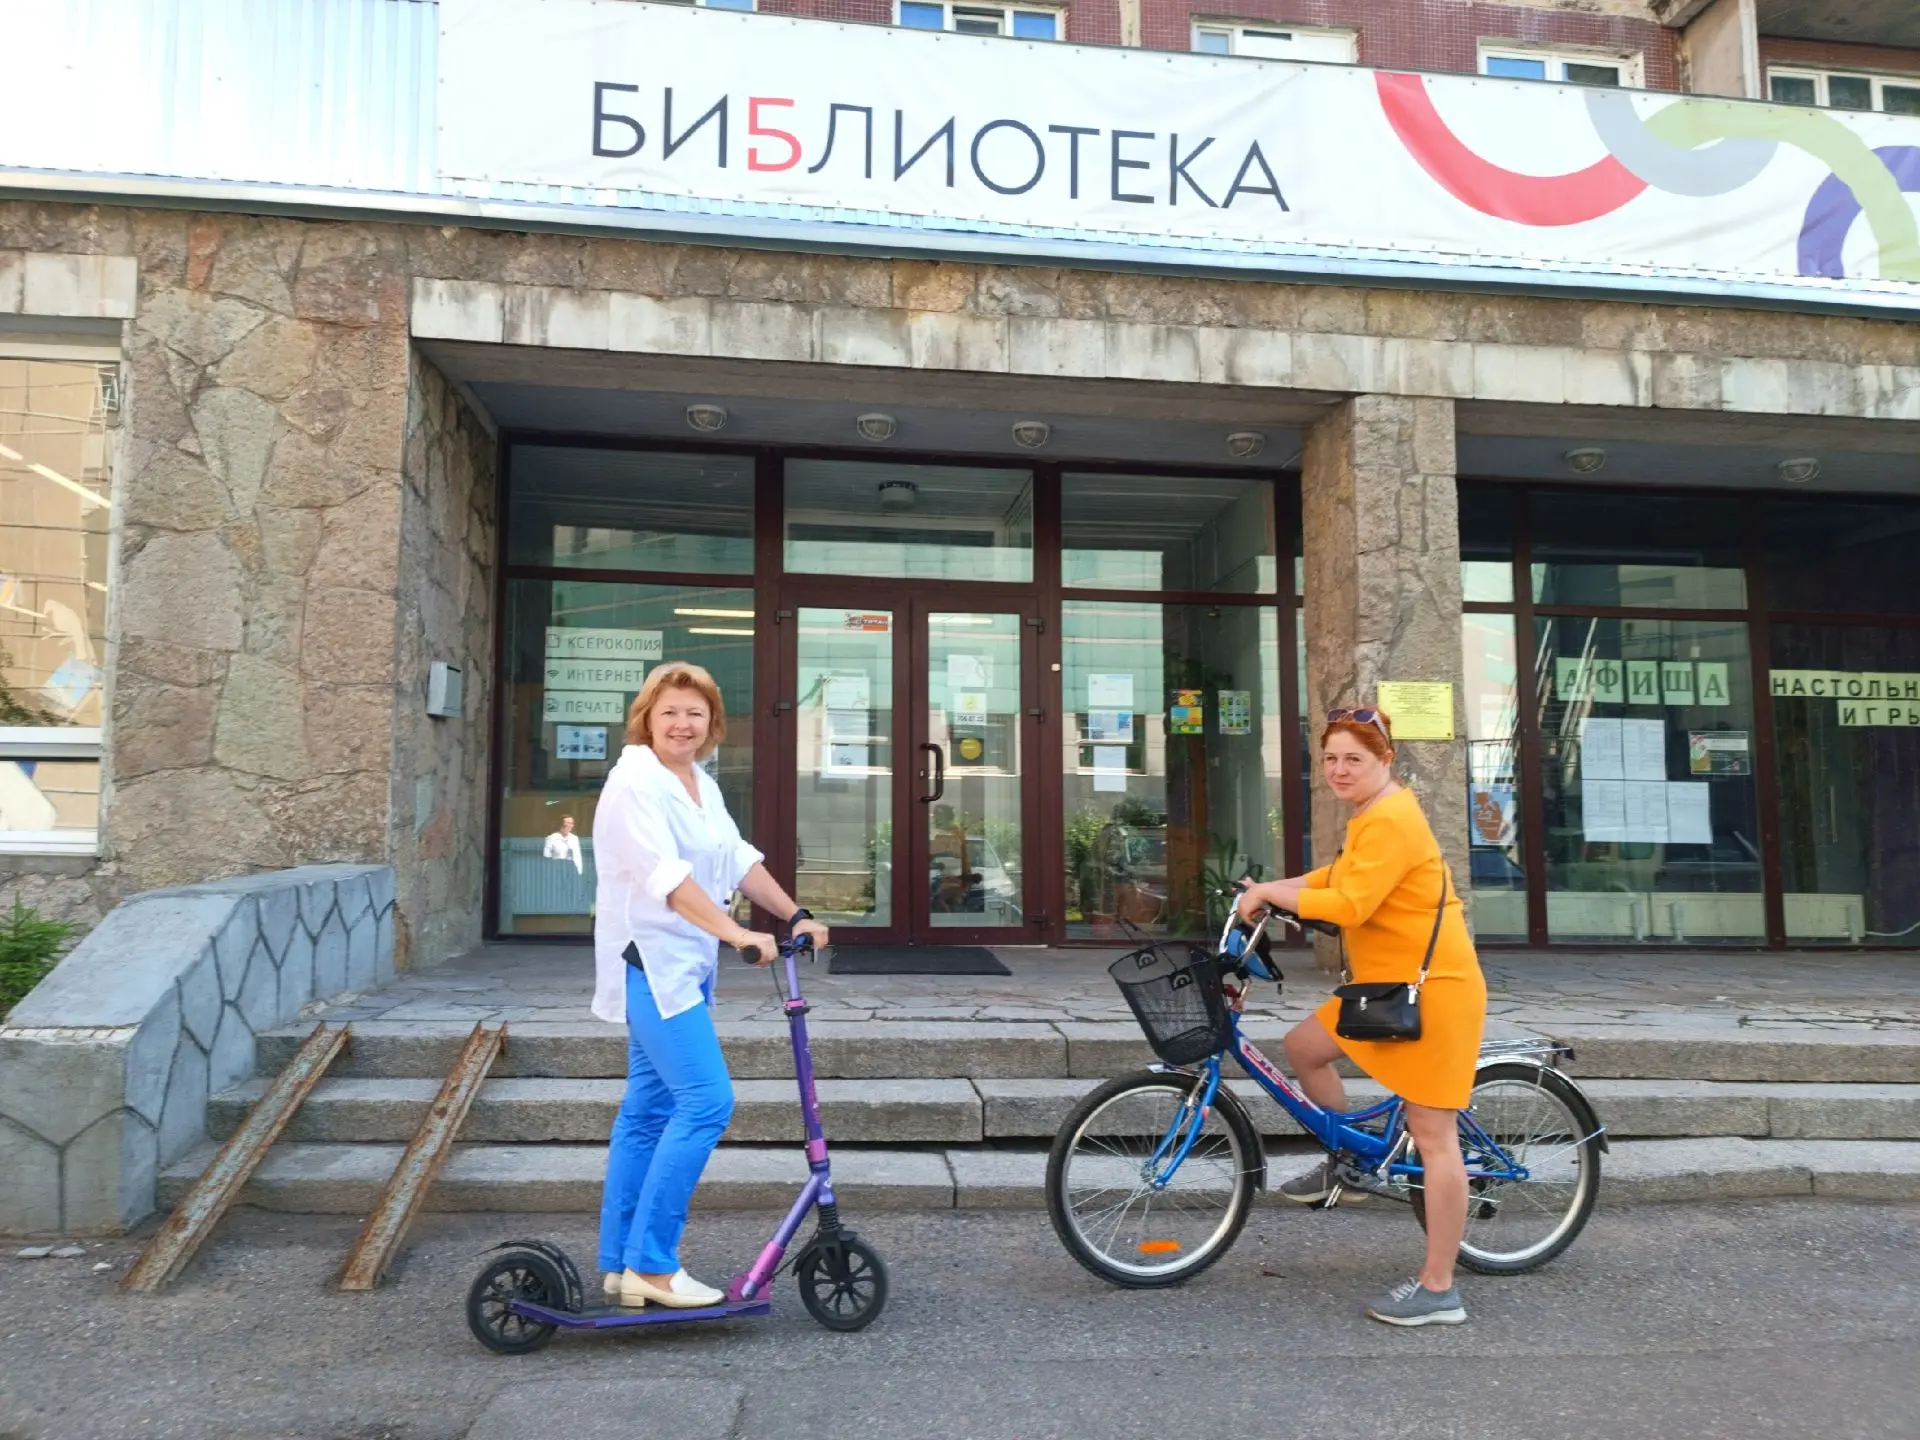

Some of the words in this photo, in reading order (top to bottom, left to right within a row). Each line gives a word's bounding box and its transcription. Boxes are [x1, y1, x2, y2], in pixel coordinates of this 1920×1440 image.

[567, 637, 662, 652] КСЕРОКОПИЯ
[566, 668, 643, 684] ИНТЕРНЕТ
[1562, 660, 1726, 698] АФИША
[565, 699, 625, 715] ПЕЧАТЬ
